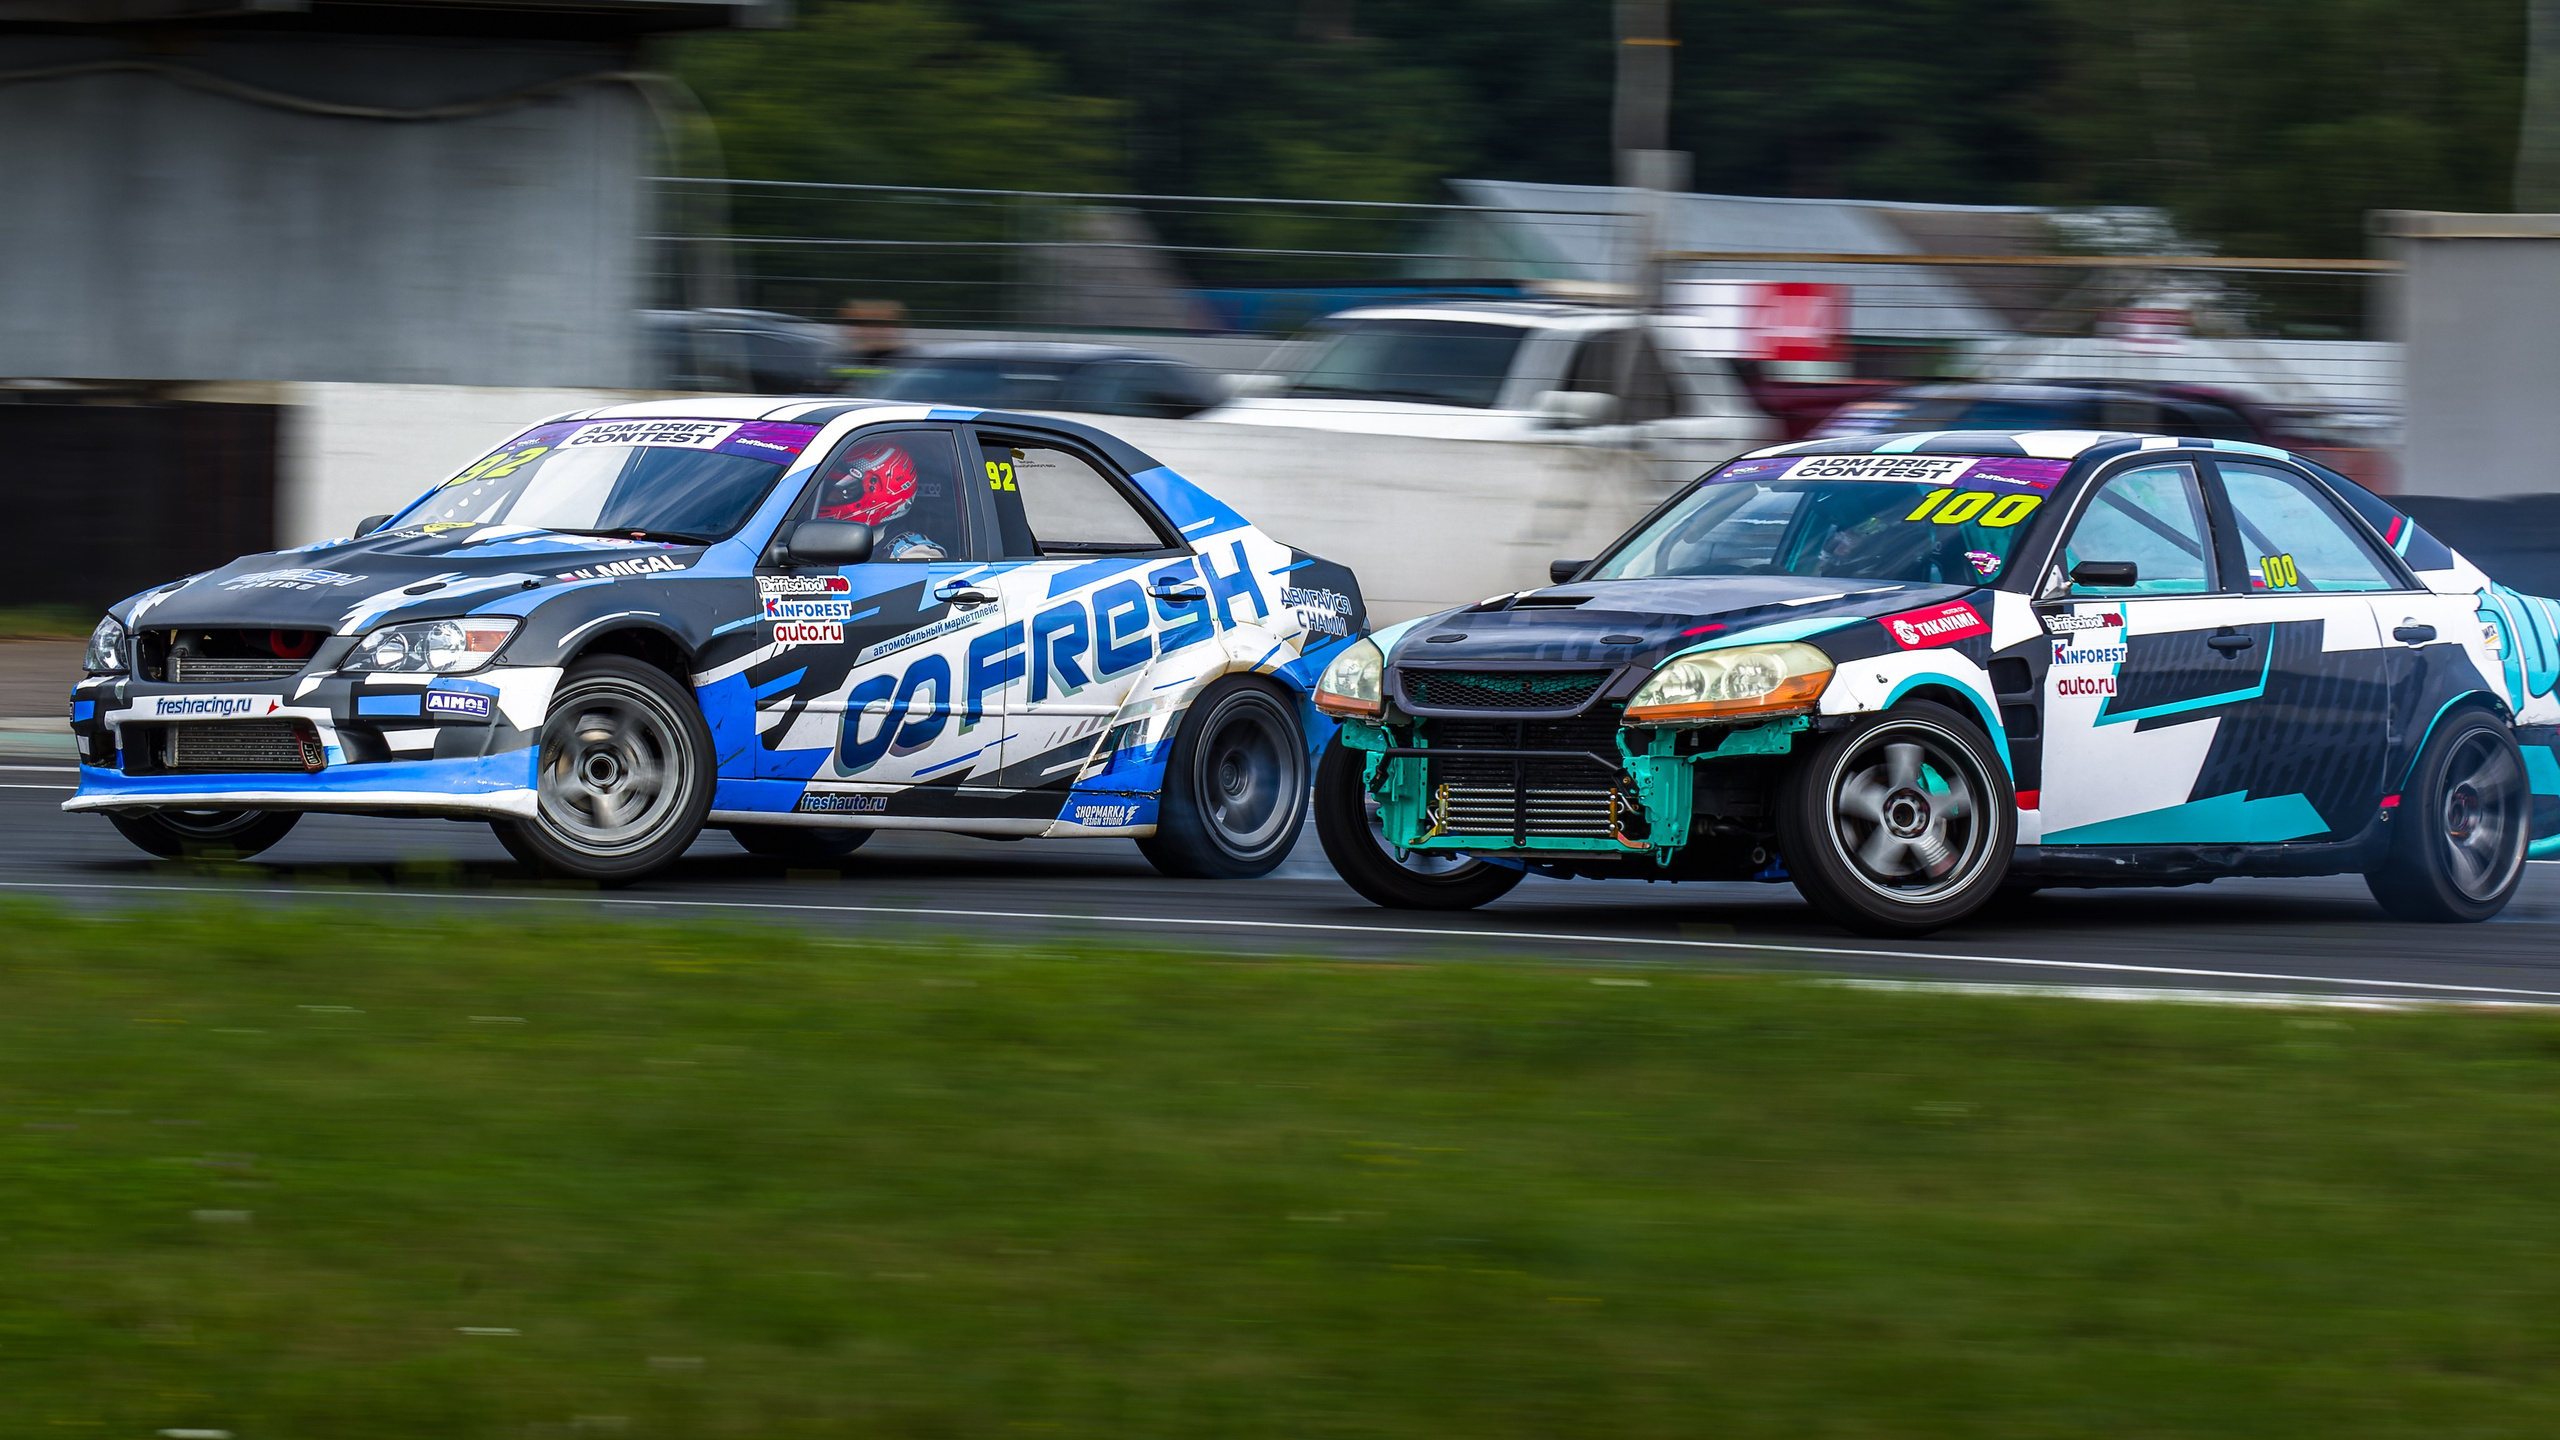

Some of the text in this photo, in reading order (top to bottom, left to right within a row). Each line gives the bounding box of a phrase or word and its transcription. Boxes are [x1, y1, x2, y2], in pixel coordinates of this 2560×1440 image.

[584, 422, 728, 434] ADM DRIFT
[571, 433, 715, 446] CONTEST
[446, 446, 549, 488] 92
[1796, 466, 1952, 480] CONTEST
[1806, 458, 1963, 470] ADM DRIFT
[985, 461, 1016, 492] 92
[1904, 487, 2045, 528] 100
[2260, 553, 2298, 589] 100
[765, 597, 849, 617] KINFOREST
[1280, 587, 1353, 616] ДВИГАЙСЯ
[775, 623, 842, 642] auto.ru
[873, 603, 999, 656] автомобильный маркетплейс
[1307, 611, 1348, 636] НАМИ
[1914, 612, 1980, 636] TAKAYAMA
[2054, 643, 2126, 665] KINFOREST
[2058, 676, 2115, 695] auto.ru
[156, 696, 253, 717] freshracing.ru
[429, 695, 486, 713] AIMOL
[801, 792, 887, 811] freshauto.ru
[1075, 805, 1125, 818] SHOPMARKA
[1083, 818, 1123, 826] DESIGN STUDIO
